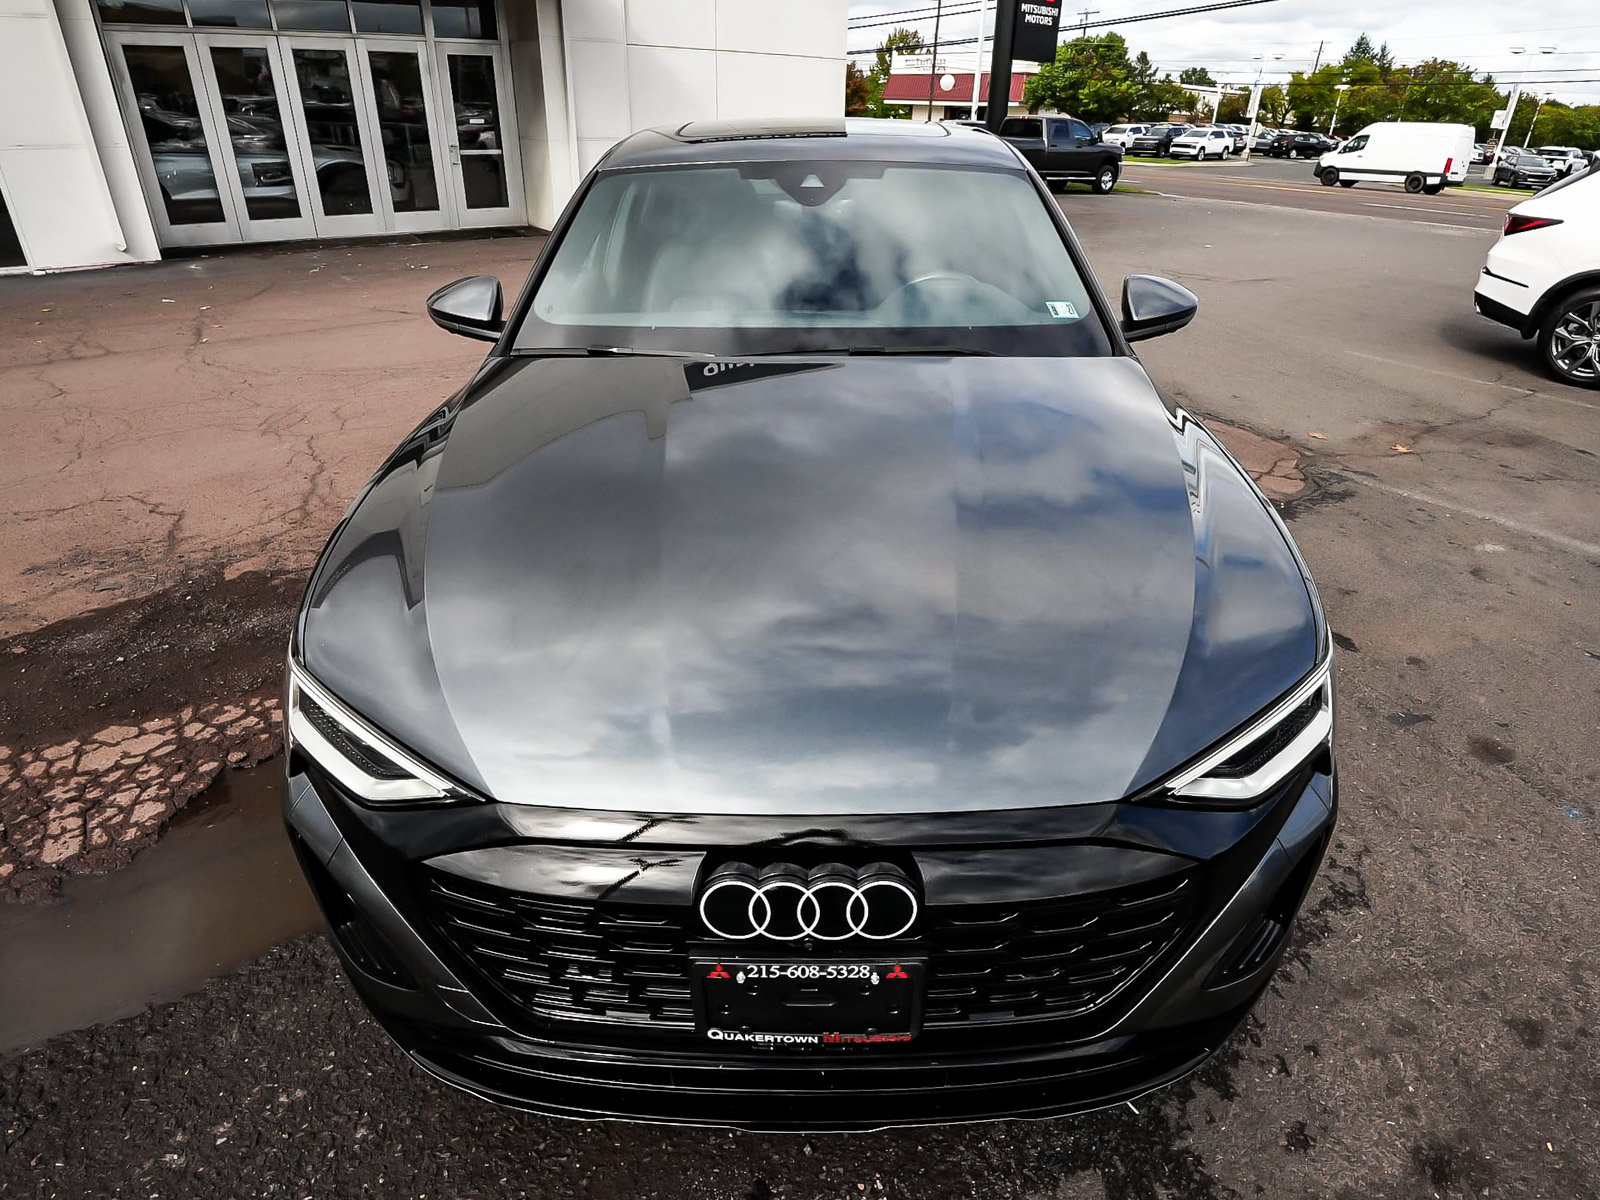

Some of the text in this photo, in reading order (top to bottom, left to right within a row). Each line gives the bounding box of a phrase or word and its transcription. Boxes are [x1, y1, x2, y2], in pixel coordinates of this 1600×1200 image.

[1021, 3, 1059, 16] MITSUBISHI
[1025, 13, 1053, 26] MOTORS
[746, 965, 870, 979] 215-608-5328
[707, 1029, 819, 1044] QUAKERTOWN
